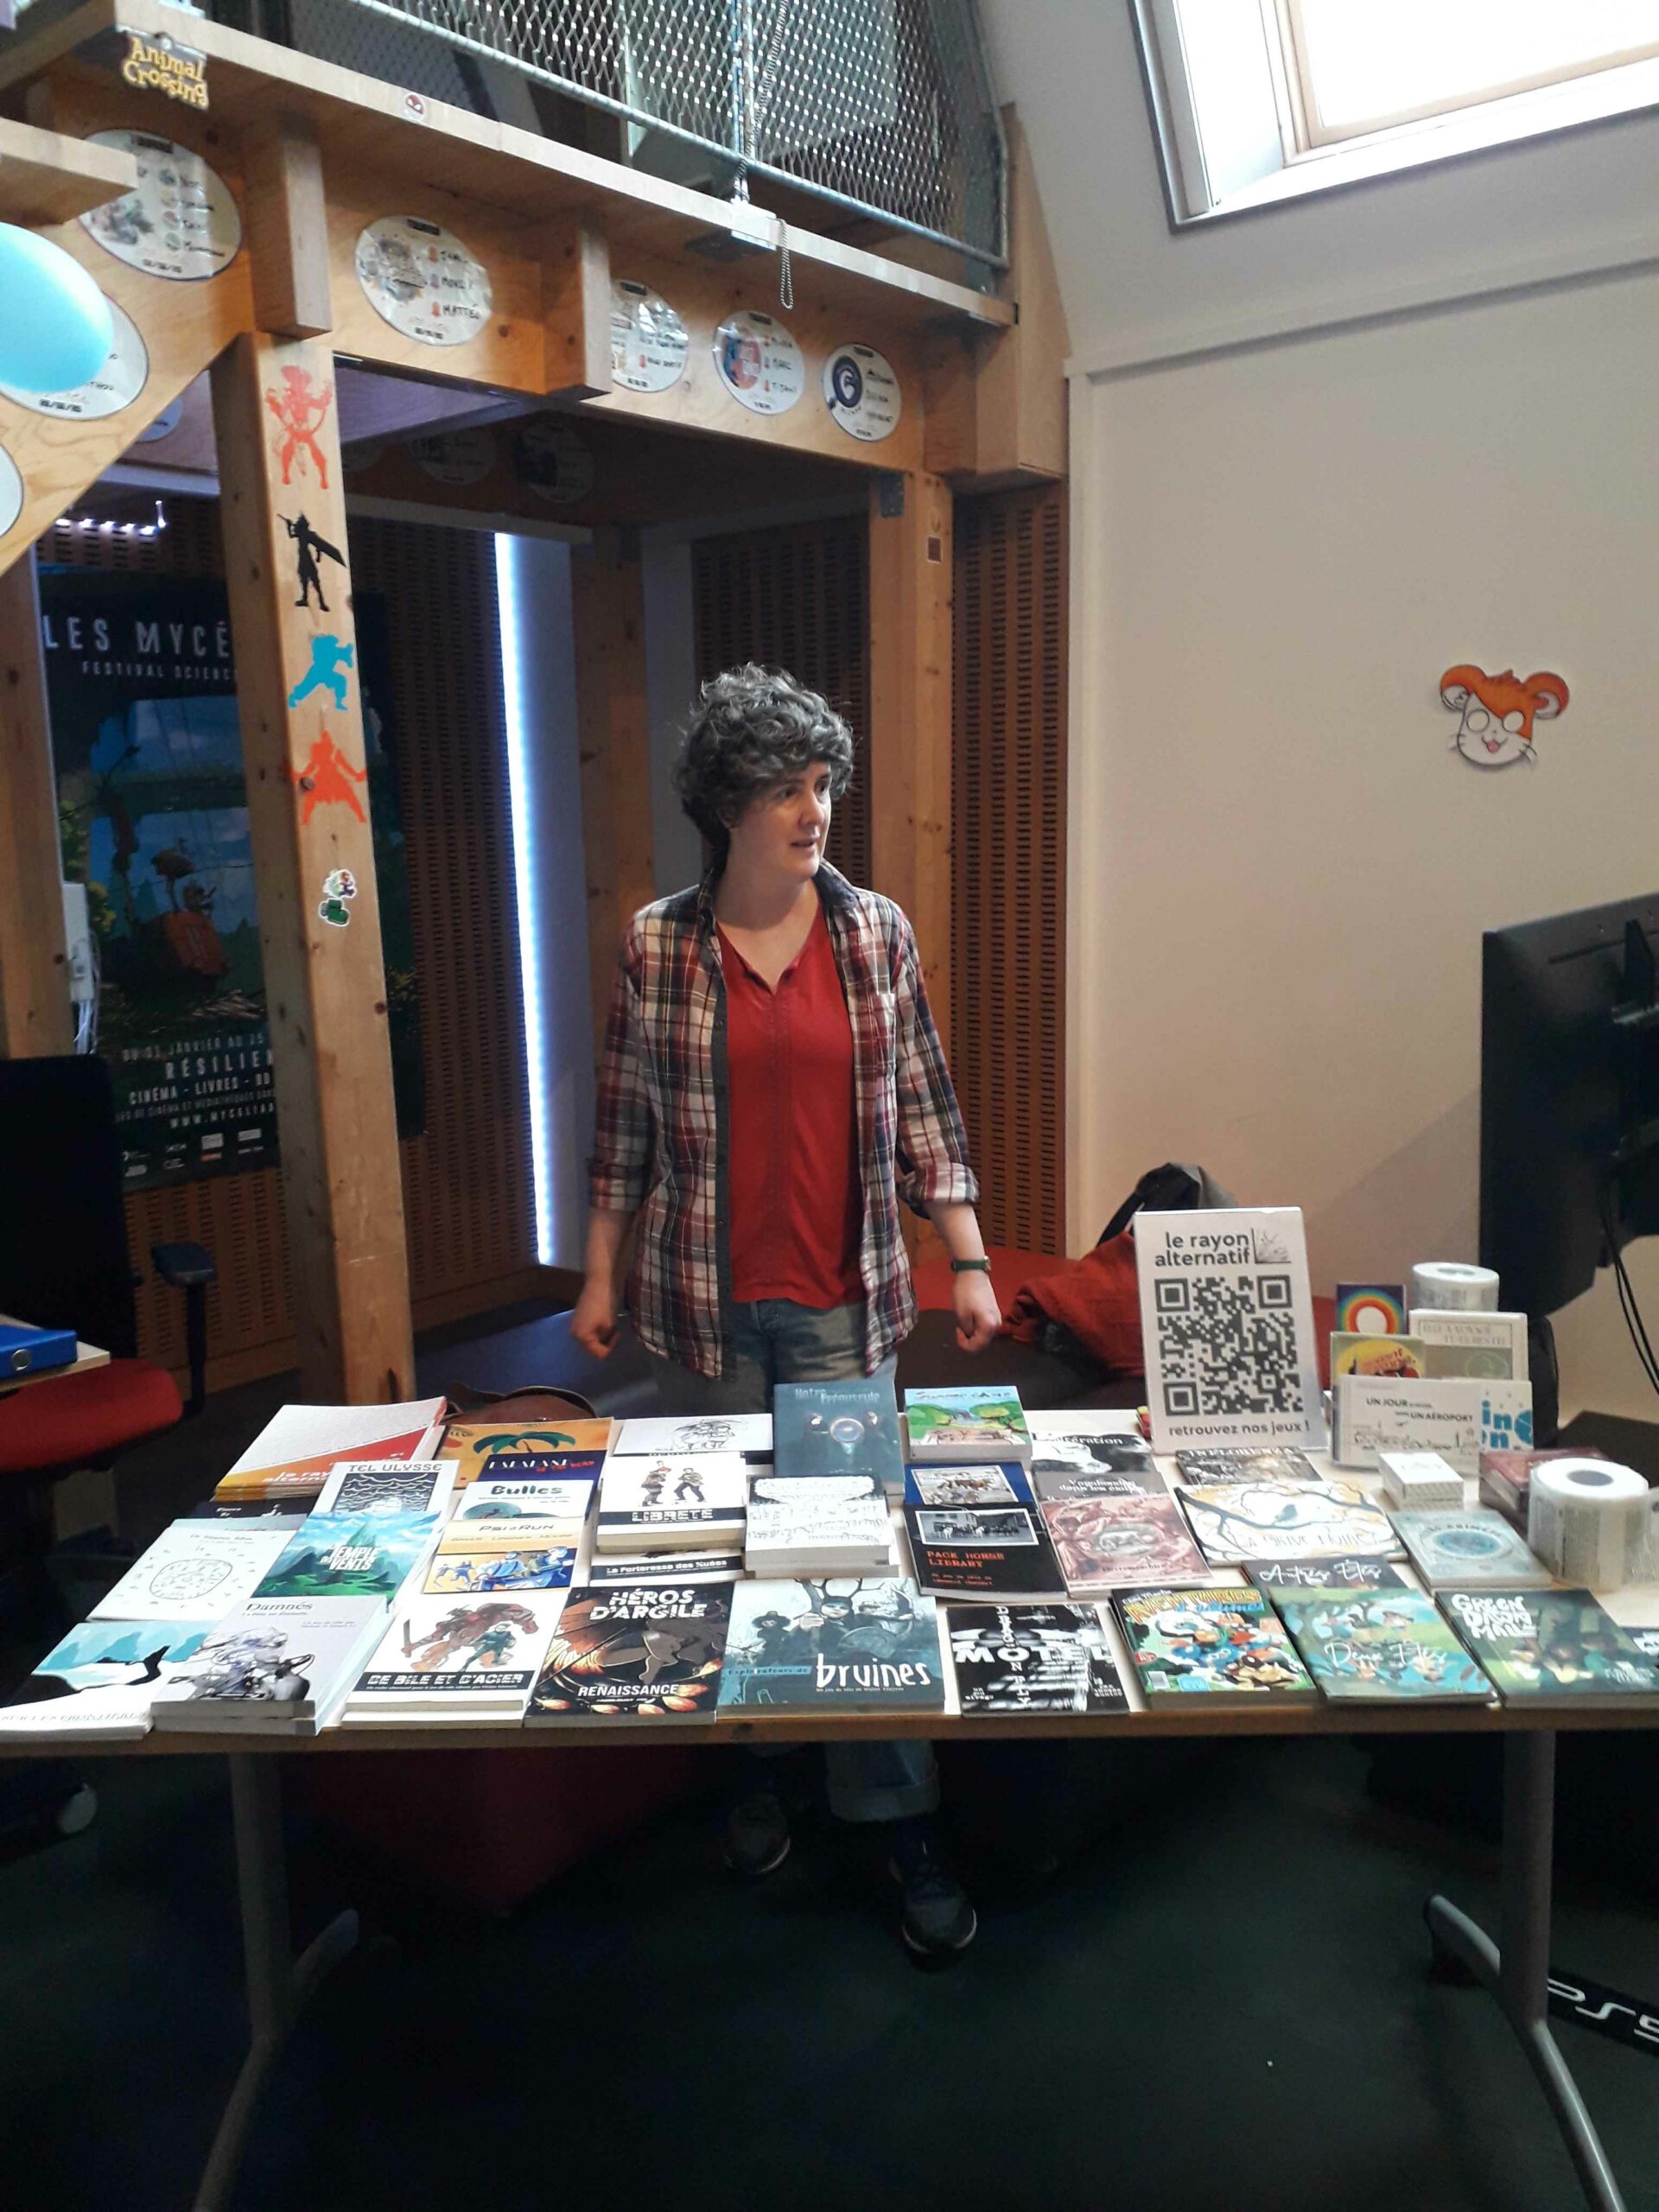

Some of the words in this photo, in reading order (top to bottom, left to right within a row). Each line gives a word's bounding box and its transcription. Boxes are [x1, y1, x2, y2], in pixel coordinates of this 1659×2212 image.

[130, 35, 204, 82] Animal
[123, 59, 209, 110] Crossing
[43, 614, 111, 652] LES
[1166, 1231, 1184, 1249] le
[1190, 1233, 1249, 1252] rayon
[1154, 1248, 1250, 1267] alternatif
[1366, 1397, 1381, 1406] UN
[1383, 1397, 1408, 1408] JOUR
[1169, 1424, 1237, 1437] retrouvez
[1242, 1424, 1268, 1433] nos
[1271, 1421, 1302, 1436] jeux
[382, 1463, 443, 1472] ULYSSE
[926, 1550, 959, 1560] PACK
[328, 1557, 375, 1571] VENTS
[620, 1564, 674, 1573] Forteresse
[696, 1560, 728, 1568] Nuées
[928, 1559, 982, 1568] LIBRARY
[608, 1588, 696, 1606] HÉROS
[246, 1602, 314, 1611] Damnés
[589, 1604, 708, 1620] D'ARGILE
[953, 1645, 1113, 1663] MOTEL
[816, 1652, 931, 1688] bruines
[367, 1675, 391, 1685] DE
[394, 1674, 433, 1685] BILE
[434, 1674, 456, 1685] ET
[459, 1673, 524, 1685] D'ACIER
[577, 1684, 679, 1697] RENAISSANCE
